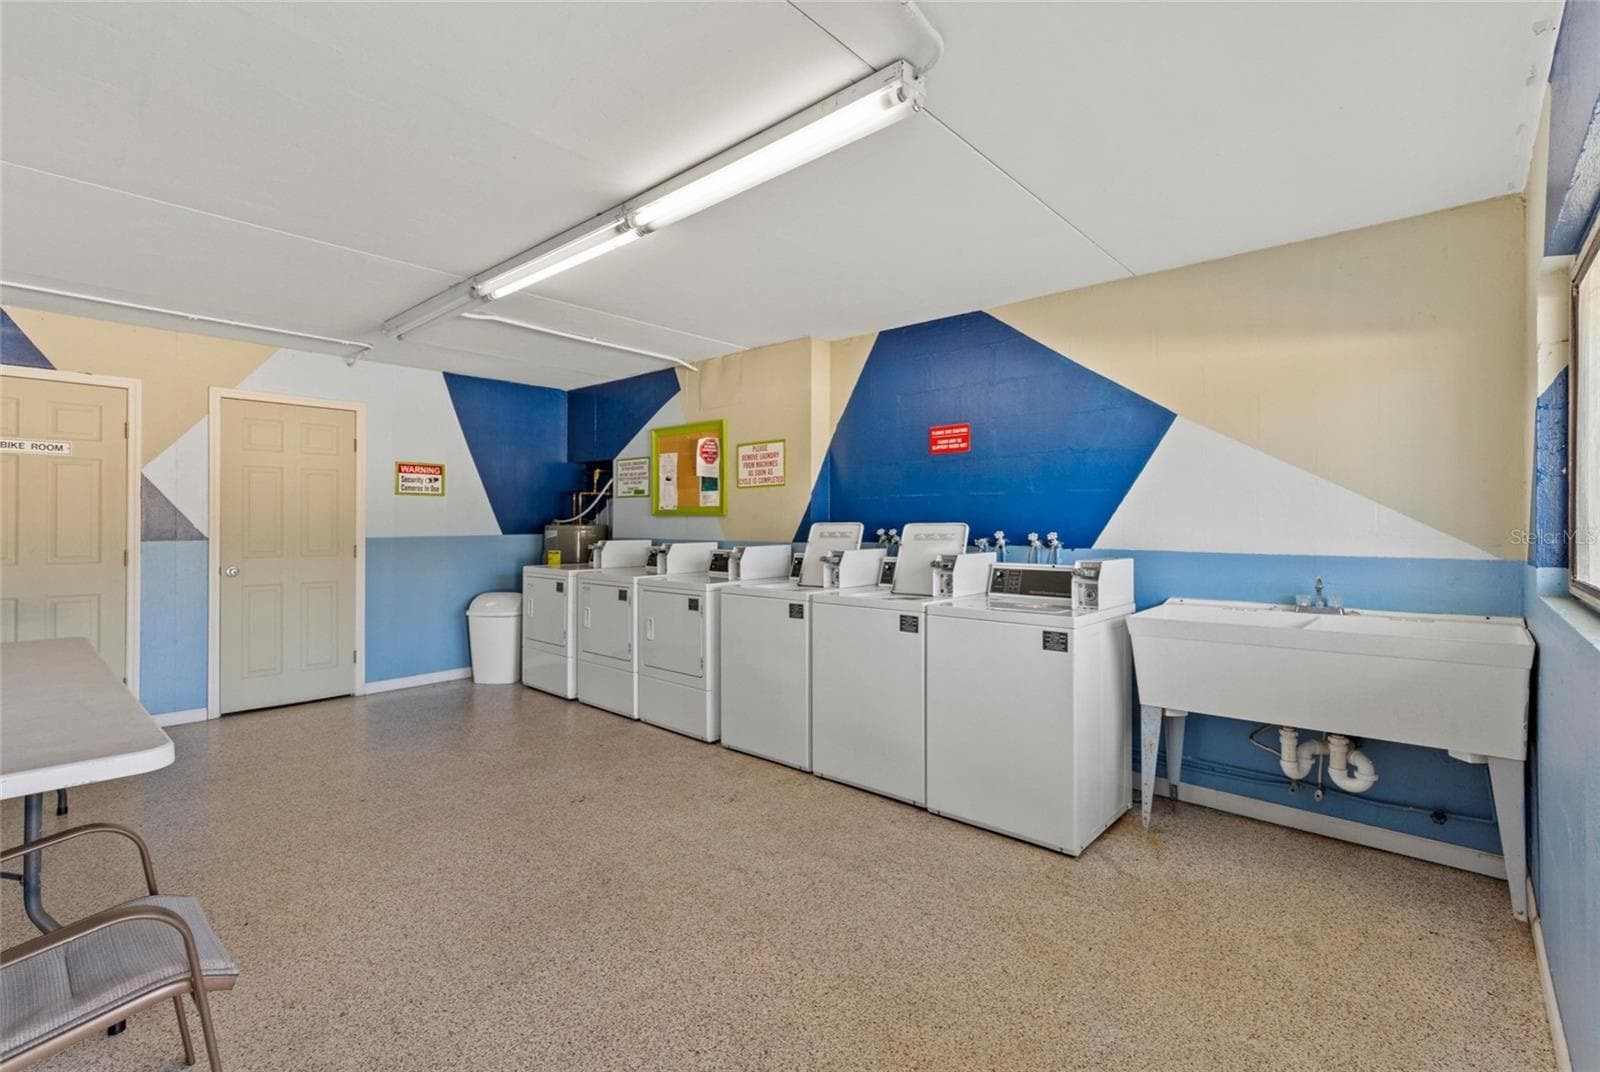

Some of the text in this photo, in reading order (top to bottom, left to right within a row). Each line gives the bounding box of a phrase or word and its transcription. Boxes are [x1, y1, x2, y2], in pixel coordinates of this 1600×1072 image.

[0, 441, 63, 452] BIKE ROOM
[752, 444, 768, 452] PLEASE
[759, 451, 779, 460] LAUNDRY
[756, 459, 778, 468] MACHINES
[400, 465, 440, 474] WARNING
[401, 475, 424, 484] Security
[758, 475, 784, 484] COMPLETED
